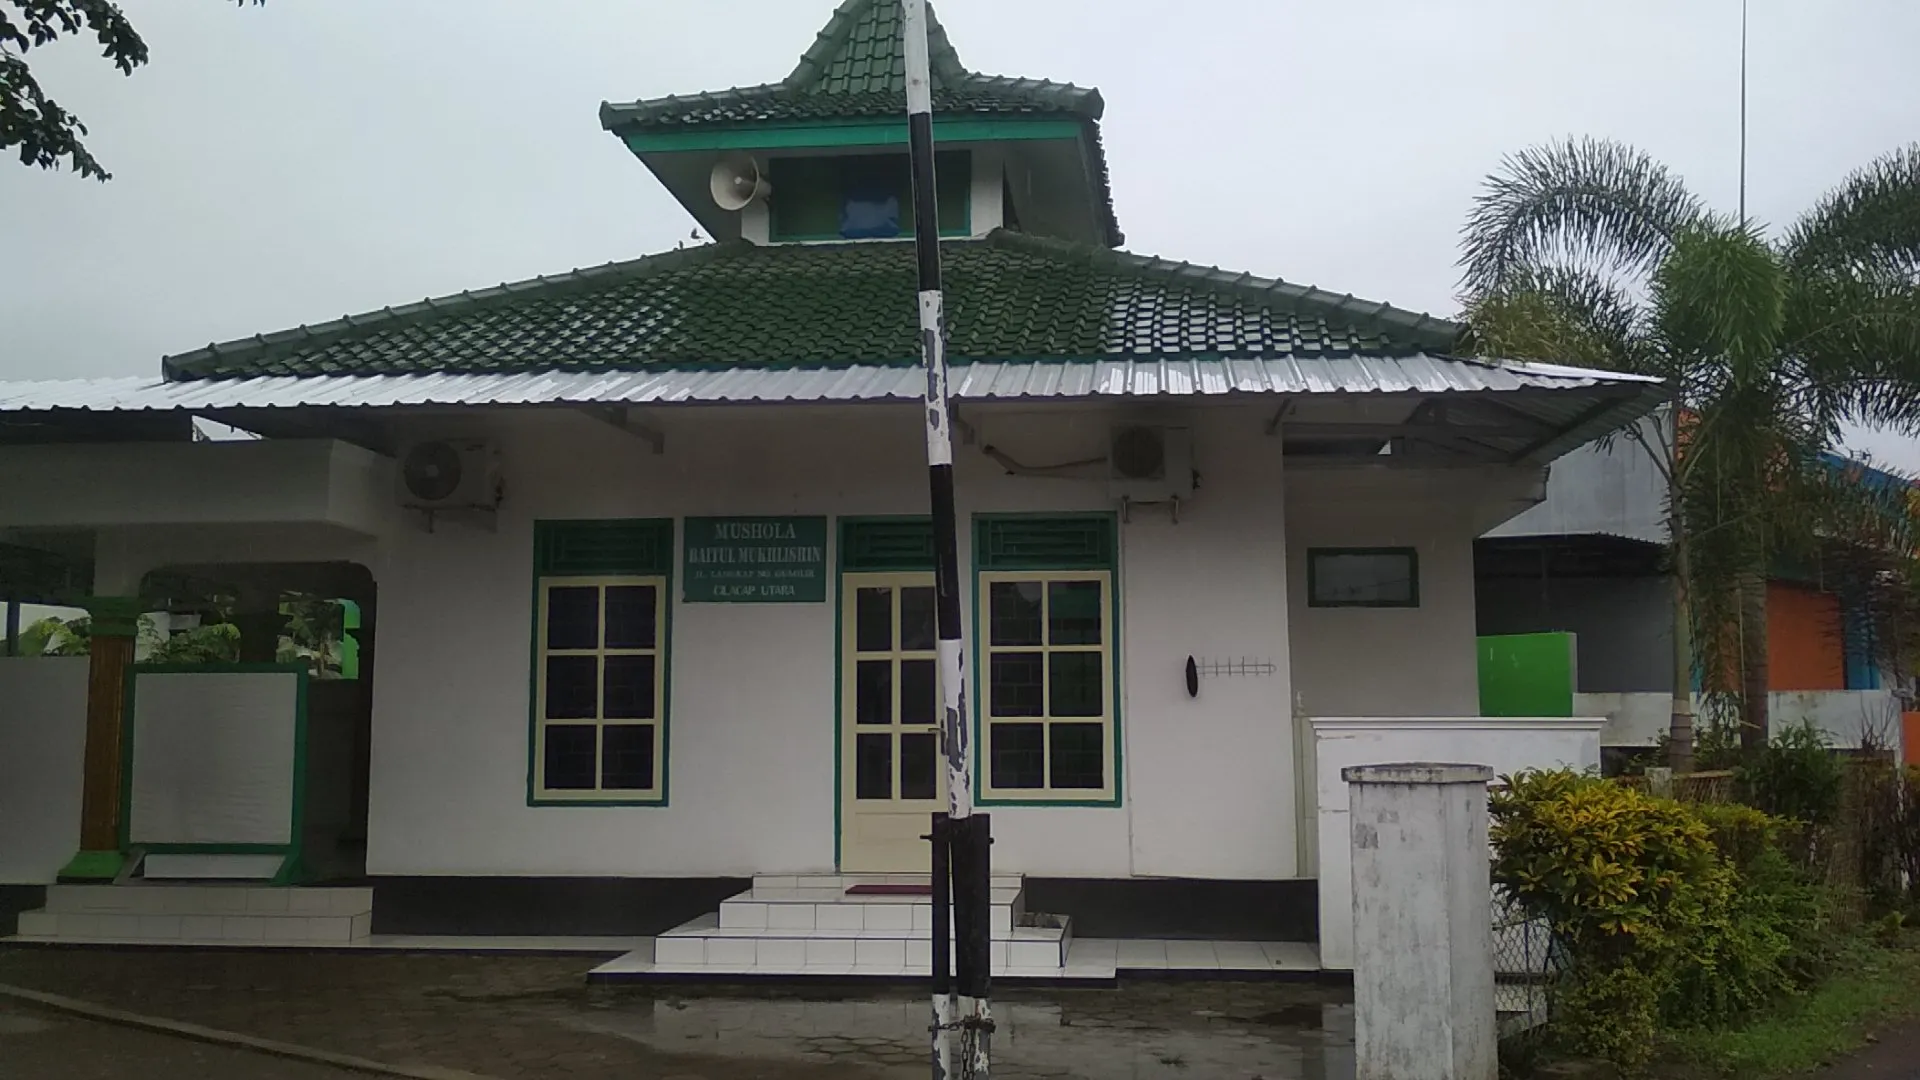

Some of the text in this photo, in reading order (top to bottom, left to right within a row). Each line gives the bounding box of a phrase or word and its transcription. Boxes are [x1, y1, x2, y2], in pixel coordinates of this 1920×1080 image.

[715, 522, 796, 539] MUSHOLA
[688, 546, 736, 562] BAITUL
[713, 584, 796, 595] CILACAP UTARA
